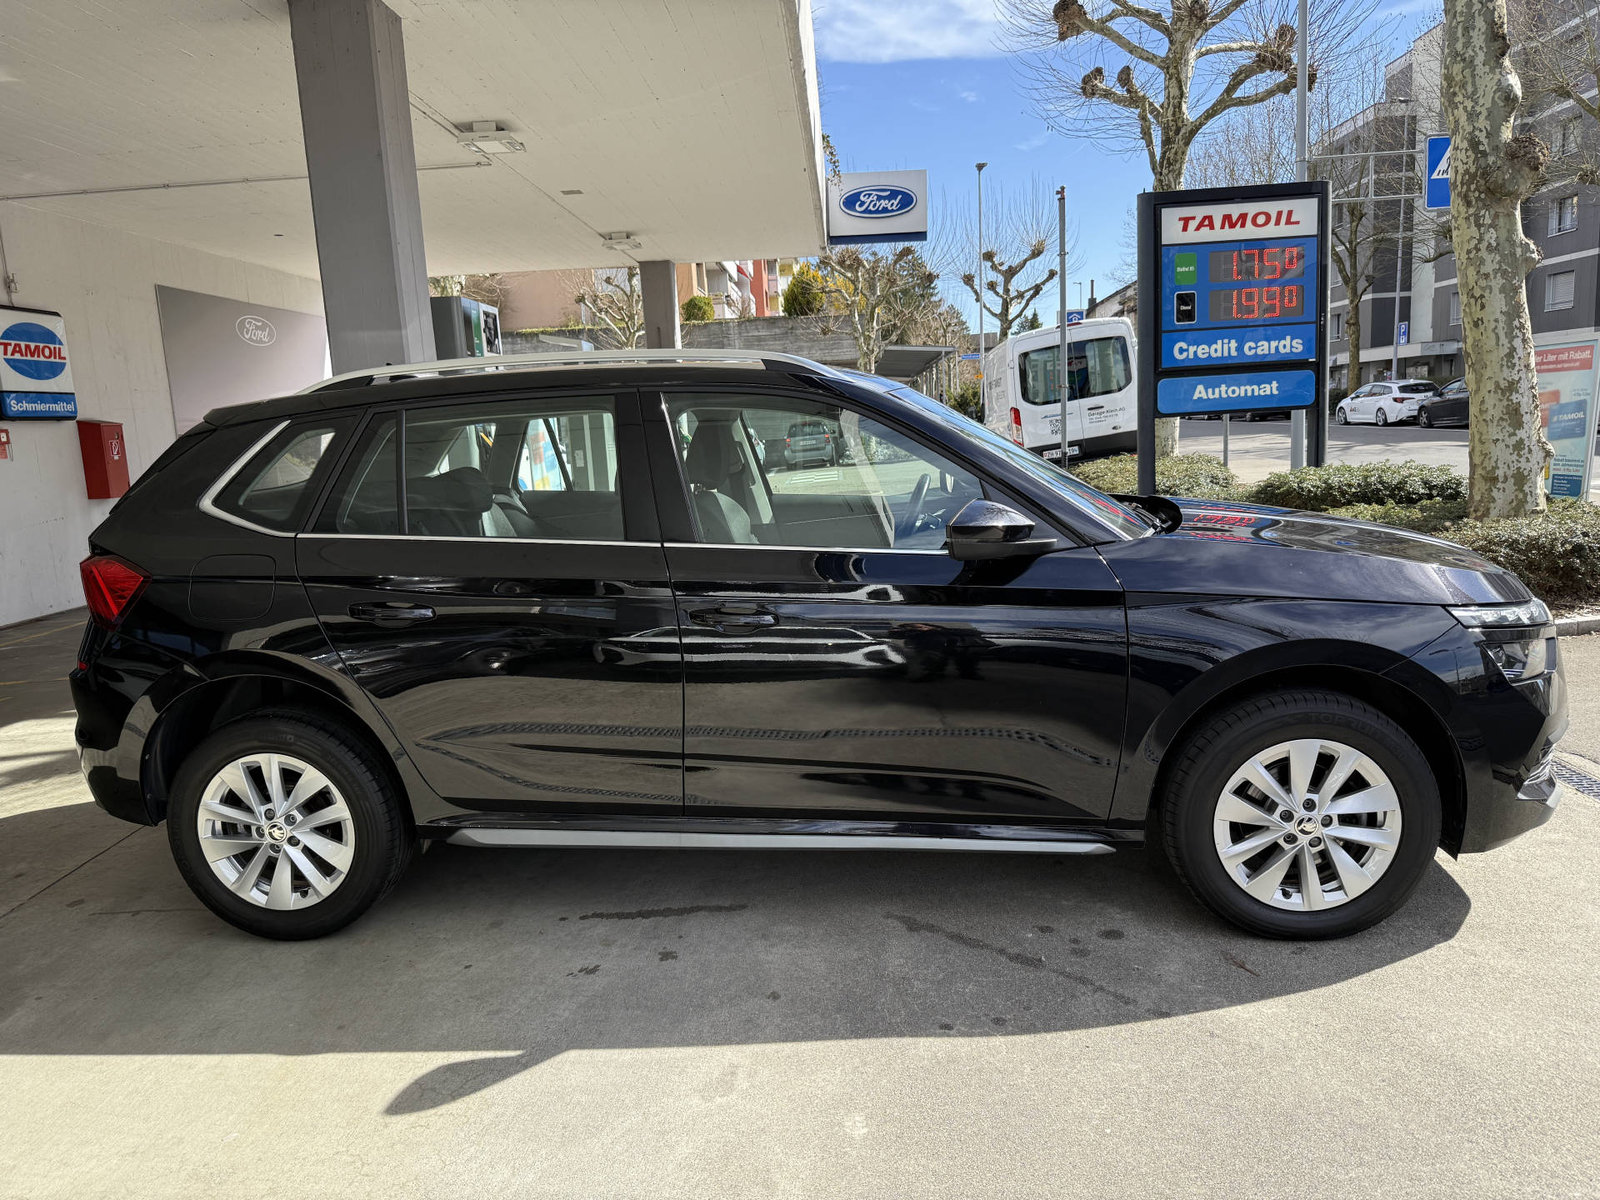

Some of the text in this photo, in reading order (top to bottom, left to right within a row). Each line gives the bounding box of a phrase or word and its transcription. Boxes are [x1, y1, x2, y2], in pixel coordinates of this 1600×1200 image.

[855, 190, 902, 212] Ford
[1178, 209, 1300, 232] TAMOIL
[243, 318, 270, 342] Ford
[0, 341, 67, 361] TAMOIL
[1173, 335, 1304, 361] Credit cards
[1543, 353, 1557, 362] Liter
[1558, 351, 1569, 361] mit
[1192, 380, 1279, 400] Automat
[10, 399, 75, 412] Schmiermittel
[1087, 410, 1105, 418] Garage
[1559, 410, 1585, 420] TAMOIL
